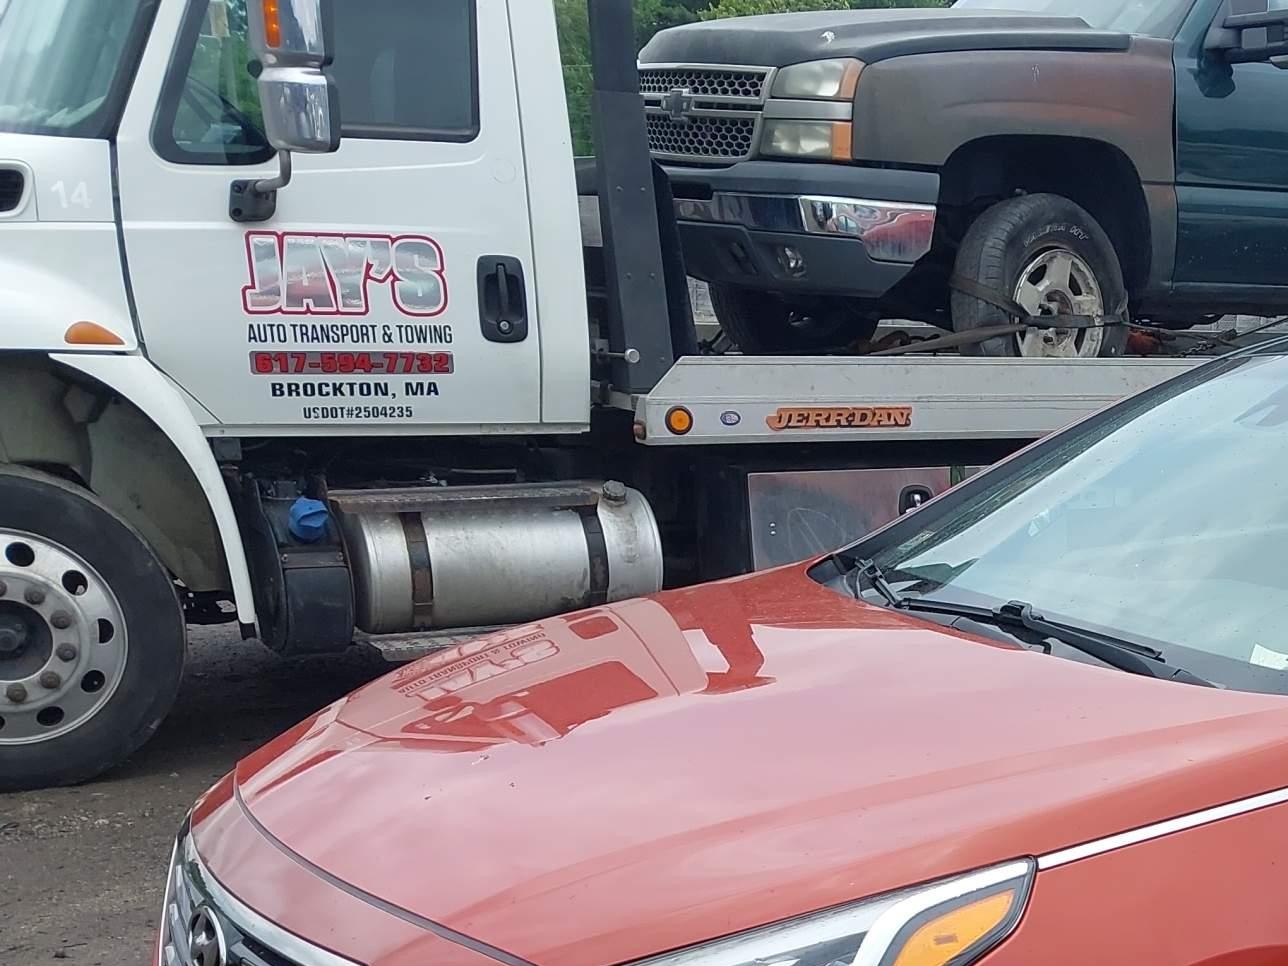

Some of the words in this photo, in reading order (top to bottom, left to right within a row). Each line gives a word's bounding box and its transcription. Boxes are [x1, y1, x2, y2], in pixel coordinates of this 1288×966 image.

[51, 181, 92, 208] 14
[243, 232, 447, 315] JAY'S
[249, 324, 287, 343] AUTO
[290, 324, 377, 343] TRANSPORT
[382, 325, 394, 343] &
[396, 325, 453, 343] TOWING
[254, 353, 450, 373] 617-594-7732
[271, 382, 396, 399] BROCKTON,
[405, 382, 439, 396] MA
[303, 407, 413, 419] USDOT#2504235
